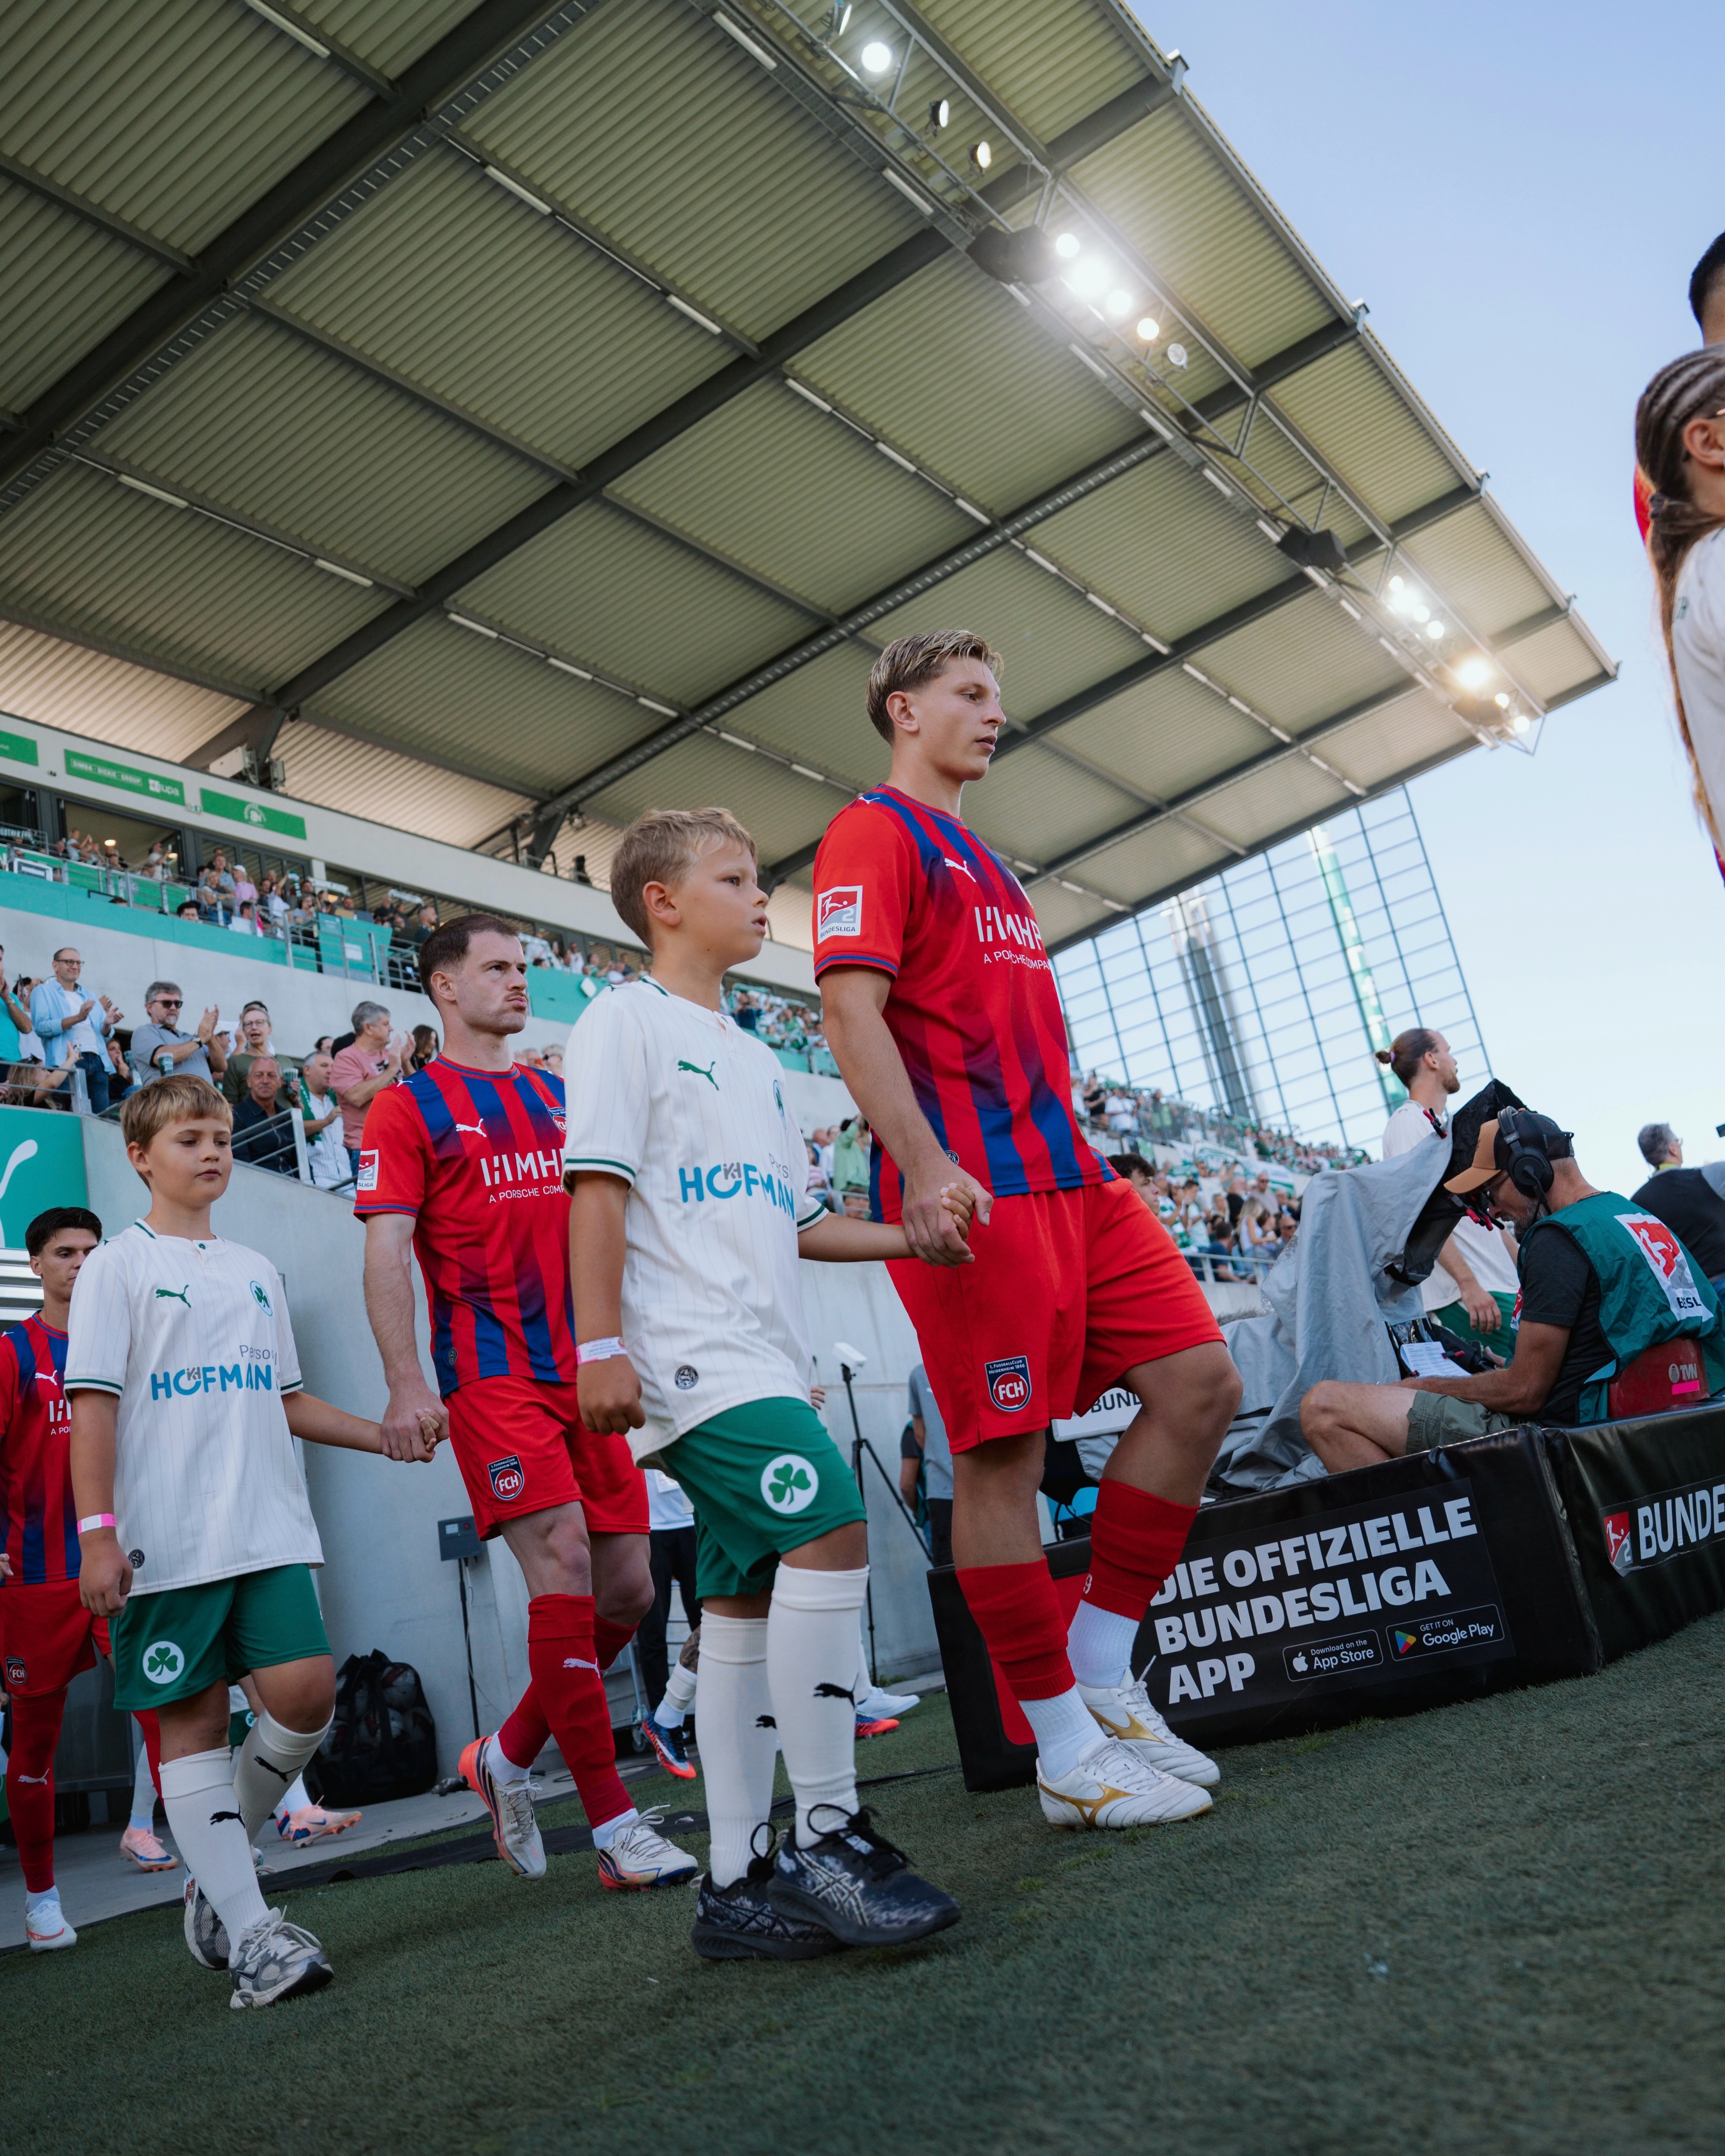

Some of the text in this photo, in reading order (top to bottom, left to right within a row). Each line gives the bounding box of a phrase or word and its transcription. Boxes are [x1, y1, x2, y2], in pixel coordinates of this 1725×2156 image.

[821, 926, 855, 938] BUNDESLIGA
[984, 953, 992, 964] A
[489, 1194, 496, 1203] A
[498, 1187, 540, 1201] PORSCHE
[1680, 1363, 1698, 1380] TVN
[998, 1381, 1024, 1400] FCH
[498, 1474, 519, 1492] FCH
[1223, 1496, 1478, 1588] OFFIZIELLE
[1154, 1559, 1451, 1655] BUNDESLIGA
[1420, 1623, 1433, 1632] GET
[1442, 1619, 1454, 1628] ON
[1422, 1623, 1494, 1646] Google Play
[1311, 1643, 1344, 1656] Download
[1313, 1648, 1374, 1670] App Store
[12, 1669, 25, 1678] FCH
[1169, 1653, 1255, 1704] APP
